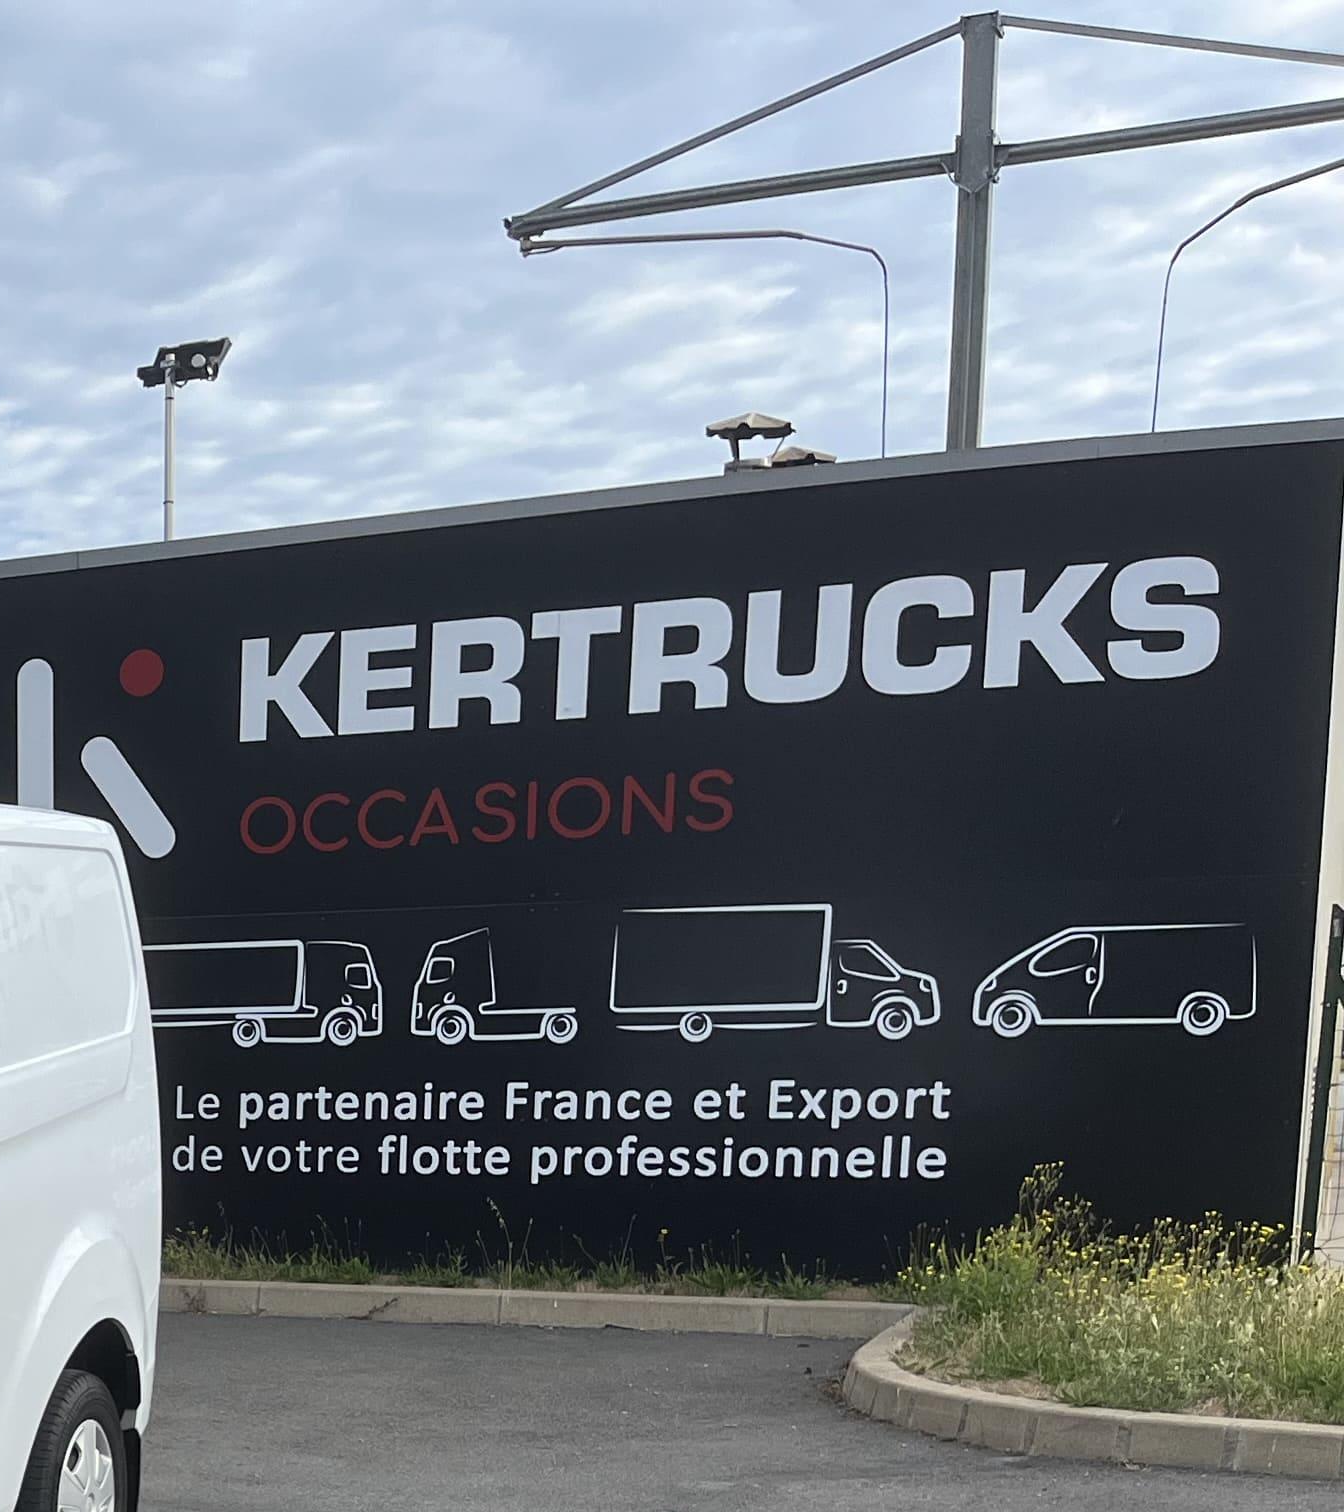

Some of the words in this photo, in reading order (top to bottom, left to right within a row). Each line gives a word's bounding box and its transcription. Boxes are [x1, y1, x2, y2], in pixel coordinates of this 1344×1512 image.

[239, 556, 1221, 743] KERTRUCKS
[240, 769, 733, 854] OCCASIONS
[176, 1085, 220, 1120] Le
[239, 1083, 485, 1129] partenaire
[505, 1081, 673, 1120] France
[693, 1083, 747, 1120] et
[768, 1080, 952, 1129] Export
[172, 1135, 223, 1172] de
[240, 1141, 360, 1173] votre
[377, 1135, 511, 1176] flotte
[530, 1135, 947, 1185] professionnelle
